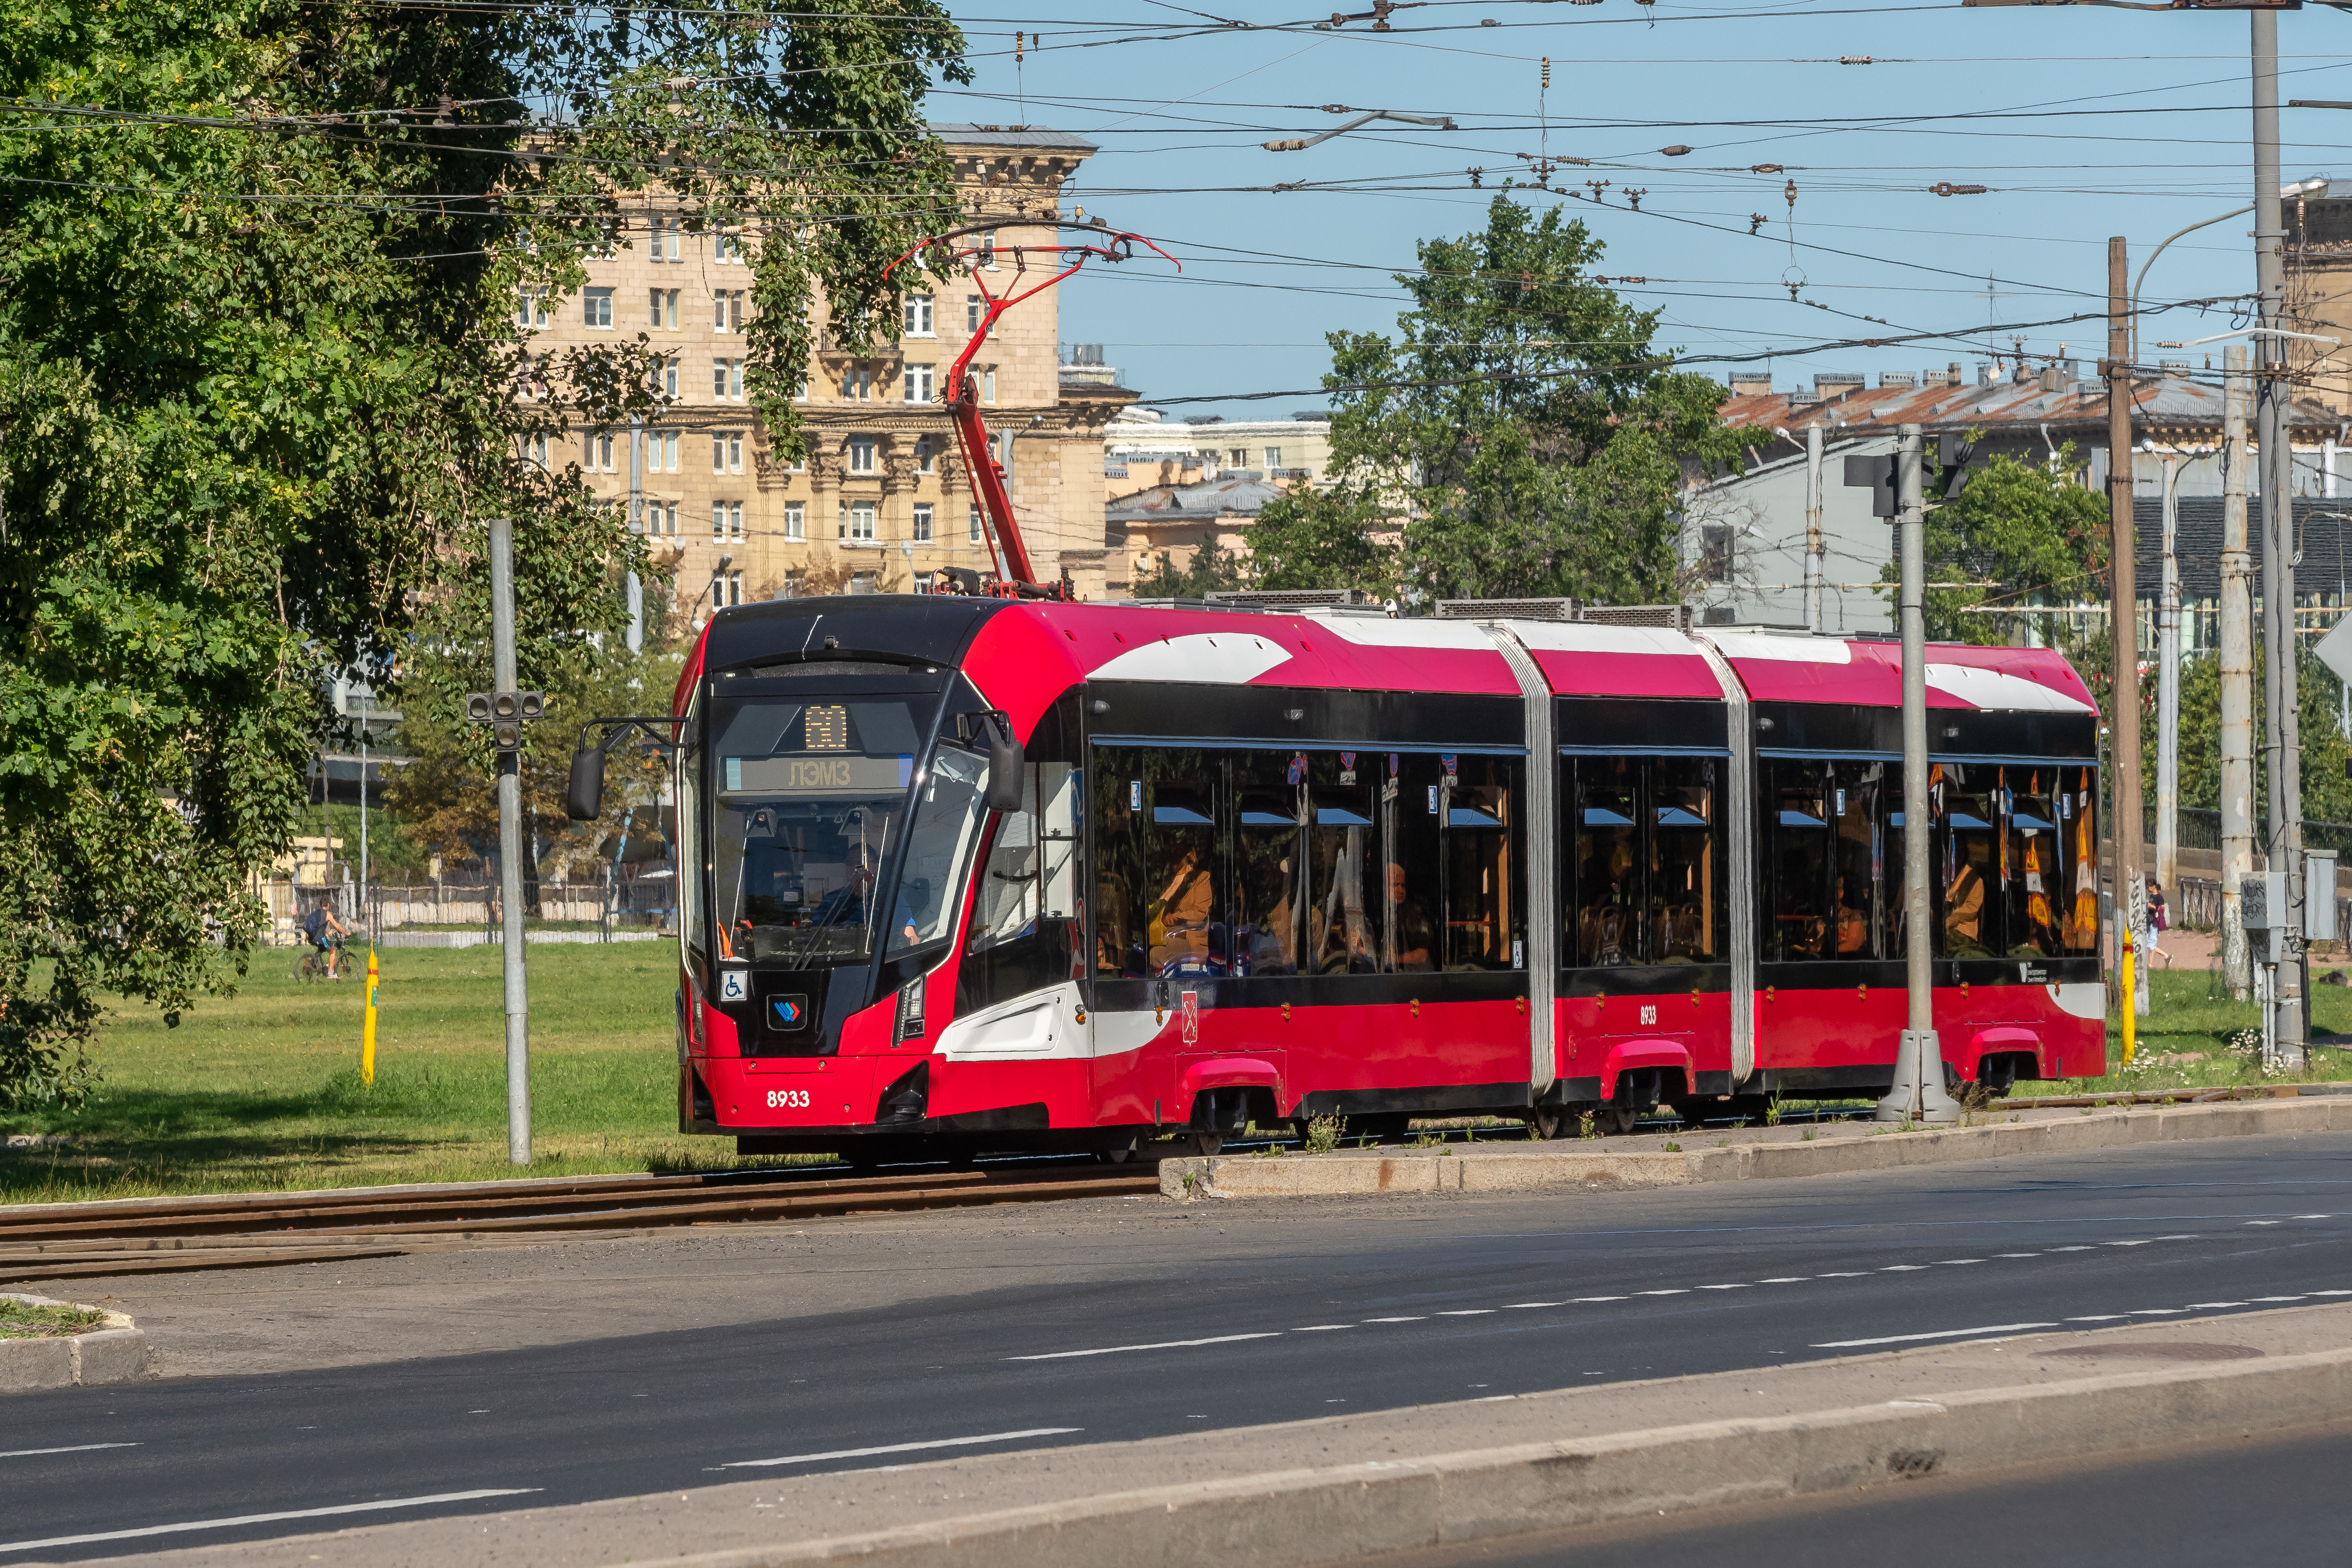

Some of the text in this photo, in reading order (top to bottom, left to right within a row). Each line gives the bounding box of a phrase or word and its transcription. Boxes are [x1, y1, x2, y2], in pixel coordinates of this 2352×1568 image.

[788, 760, 851, 787] ЛЭМЗ
[1641, 1005, 1656, 1025] 8933
[766, 1090, 810, 1108] 8933
